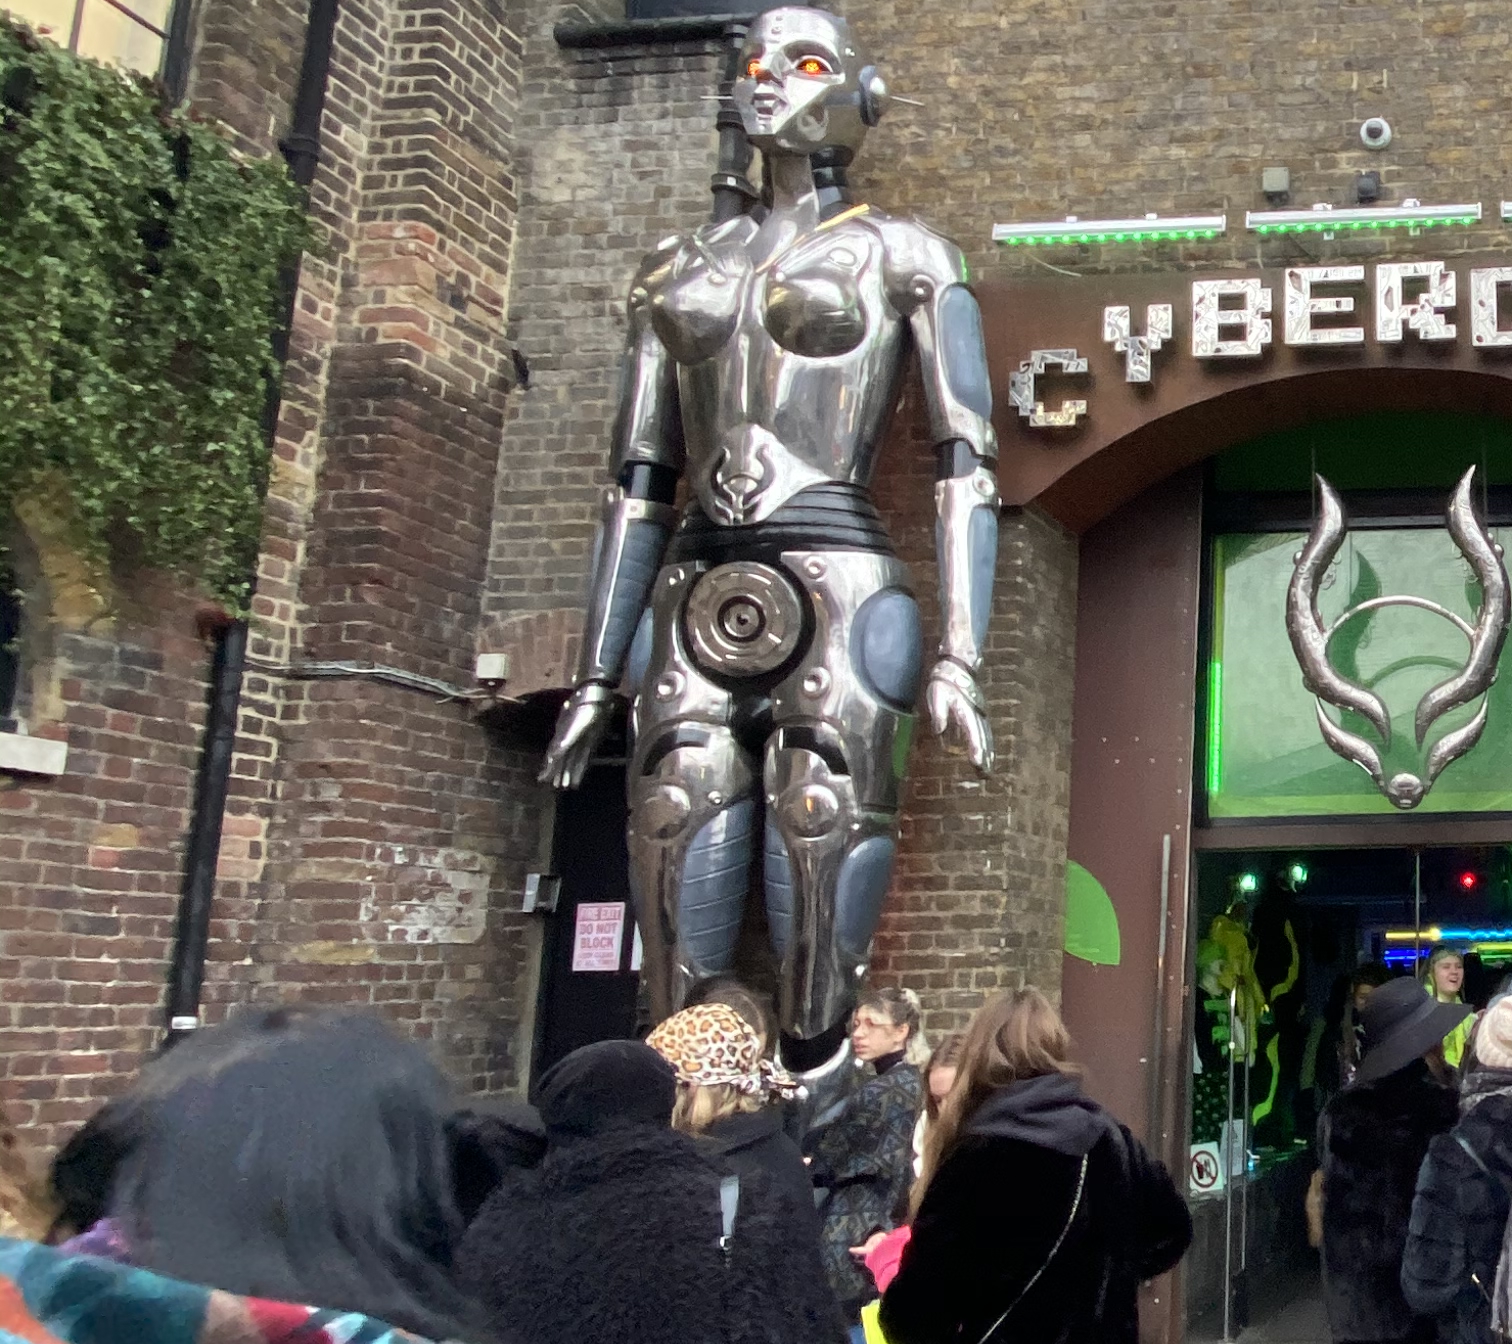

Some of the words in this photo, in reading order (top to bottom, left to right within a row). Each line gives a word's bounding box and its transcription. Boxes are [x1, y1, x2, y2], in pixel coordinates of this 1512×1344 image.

[579, 923, 594, 935] DO
[596, 922, 618, 935] NOT
[580, 937, 614, 949] BLOCK
